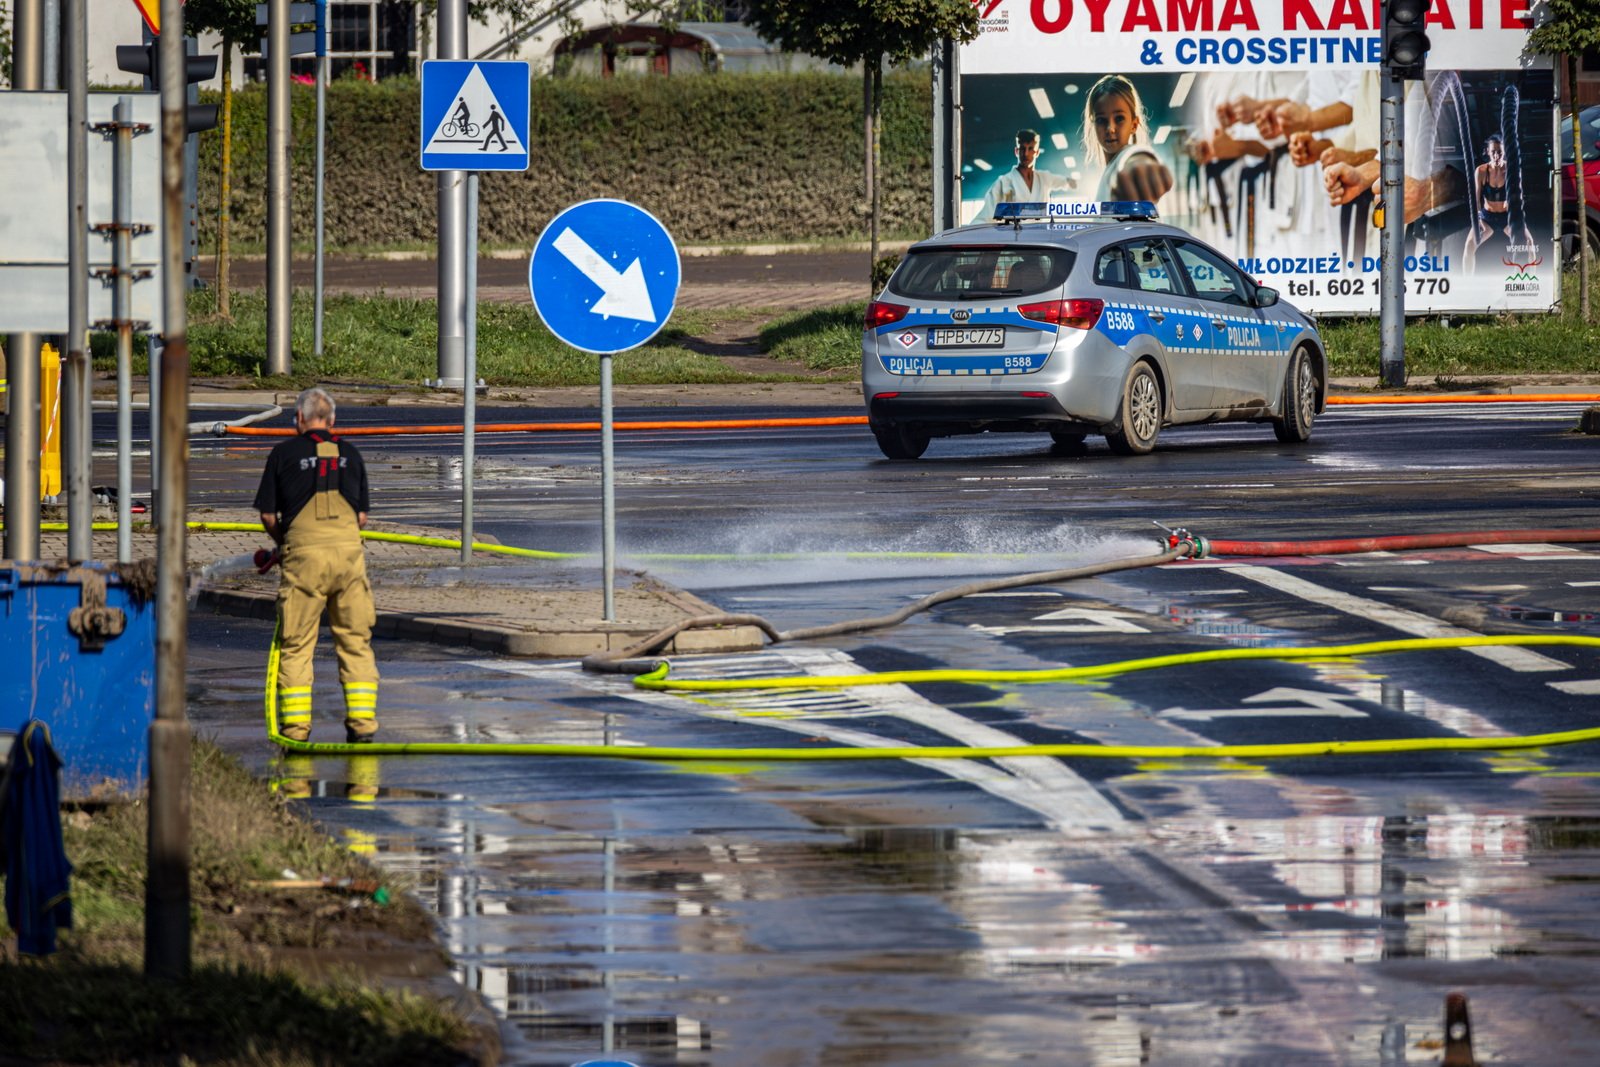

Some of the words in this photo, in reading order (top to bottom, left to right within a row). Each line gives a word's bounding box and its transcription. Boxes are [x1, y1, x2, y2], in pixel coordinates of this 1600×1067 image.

[1030, 0, 1260, 34] OYAMA
[1283, 0, 1535, 31] KAATE
[1140, 39, 1163, 65] &
[1175, 37, 1428, 64] CROSSFITNE
[1048, 203, 1098, 215] POLICJA
[1238, 252, 1341, 274] MŁODZIEŻ
[1362, 251, 1450, 272] DOŚLI
[1288, 279, 1321, 296] tel.
[1327, 279, 1365, 296] 602
[1414, 278, 1450, 295] 770
[1505, 283, 1525, 291] JELENIA
[1106, 311, 1135, 331] B588
[936, 329, 965, 344] HPB
[969, 329, 1002, 344] C775
[1227, 326, 1261, 347] POLICJA
[890, 358, 934, 370] POLICJA
[1005, 357, 1032, 367] B588
